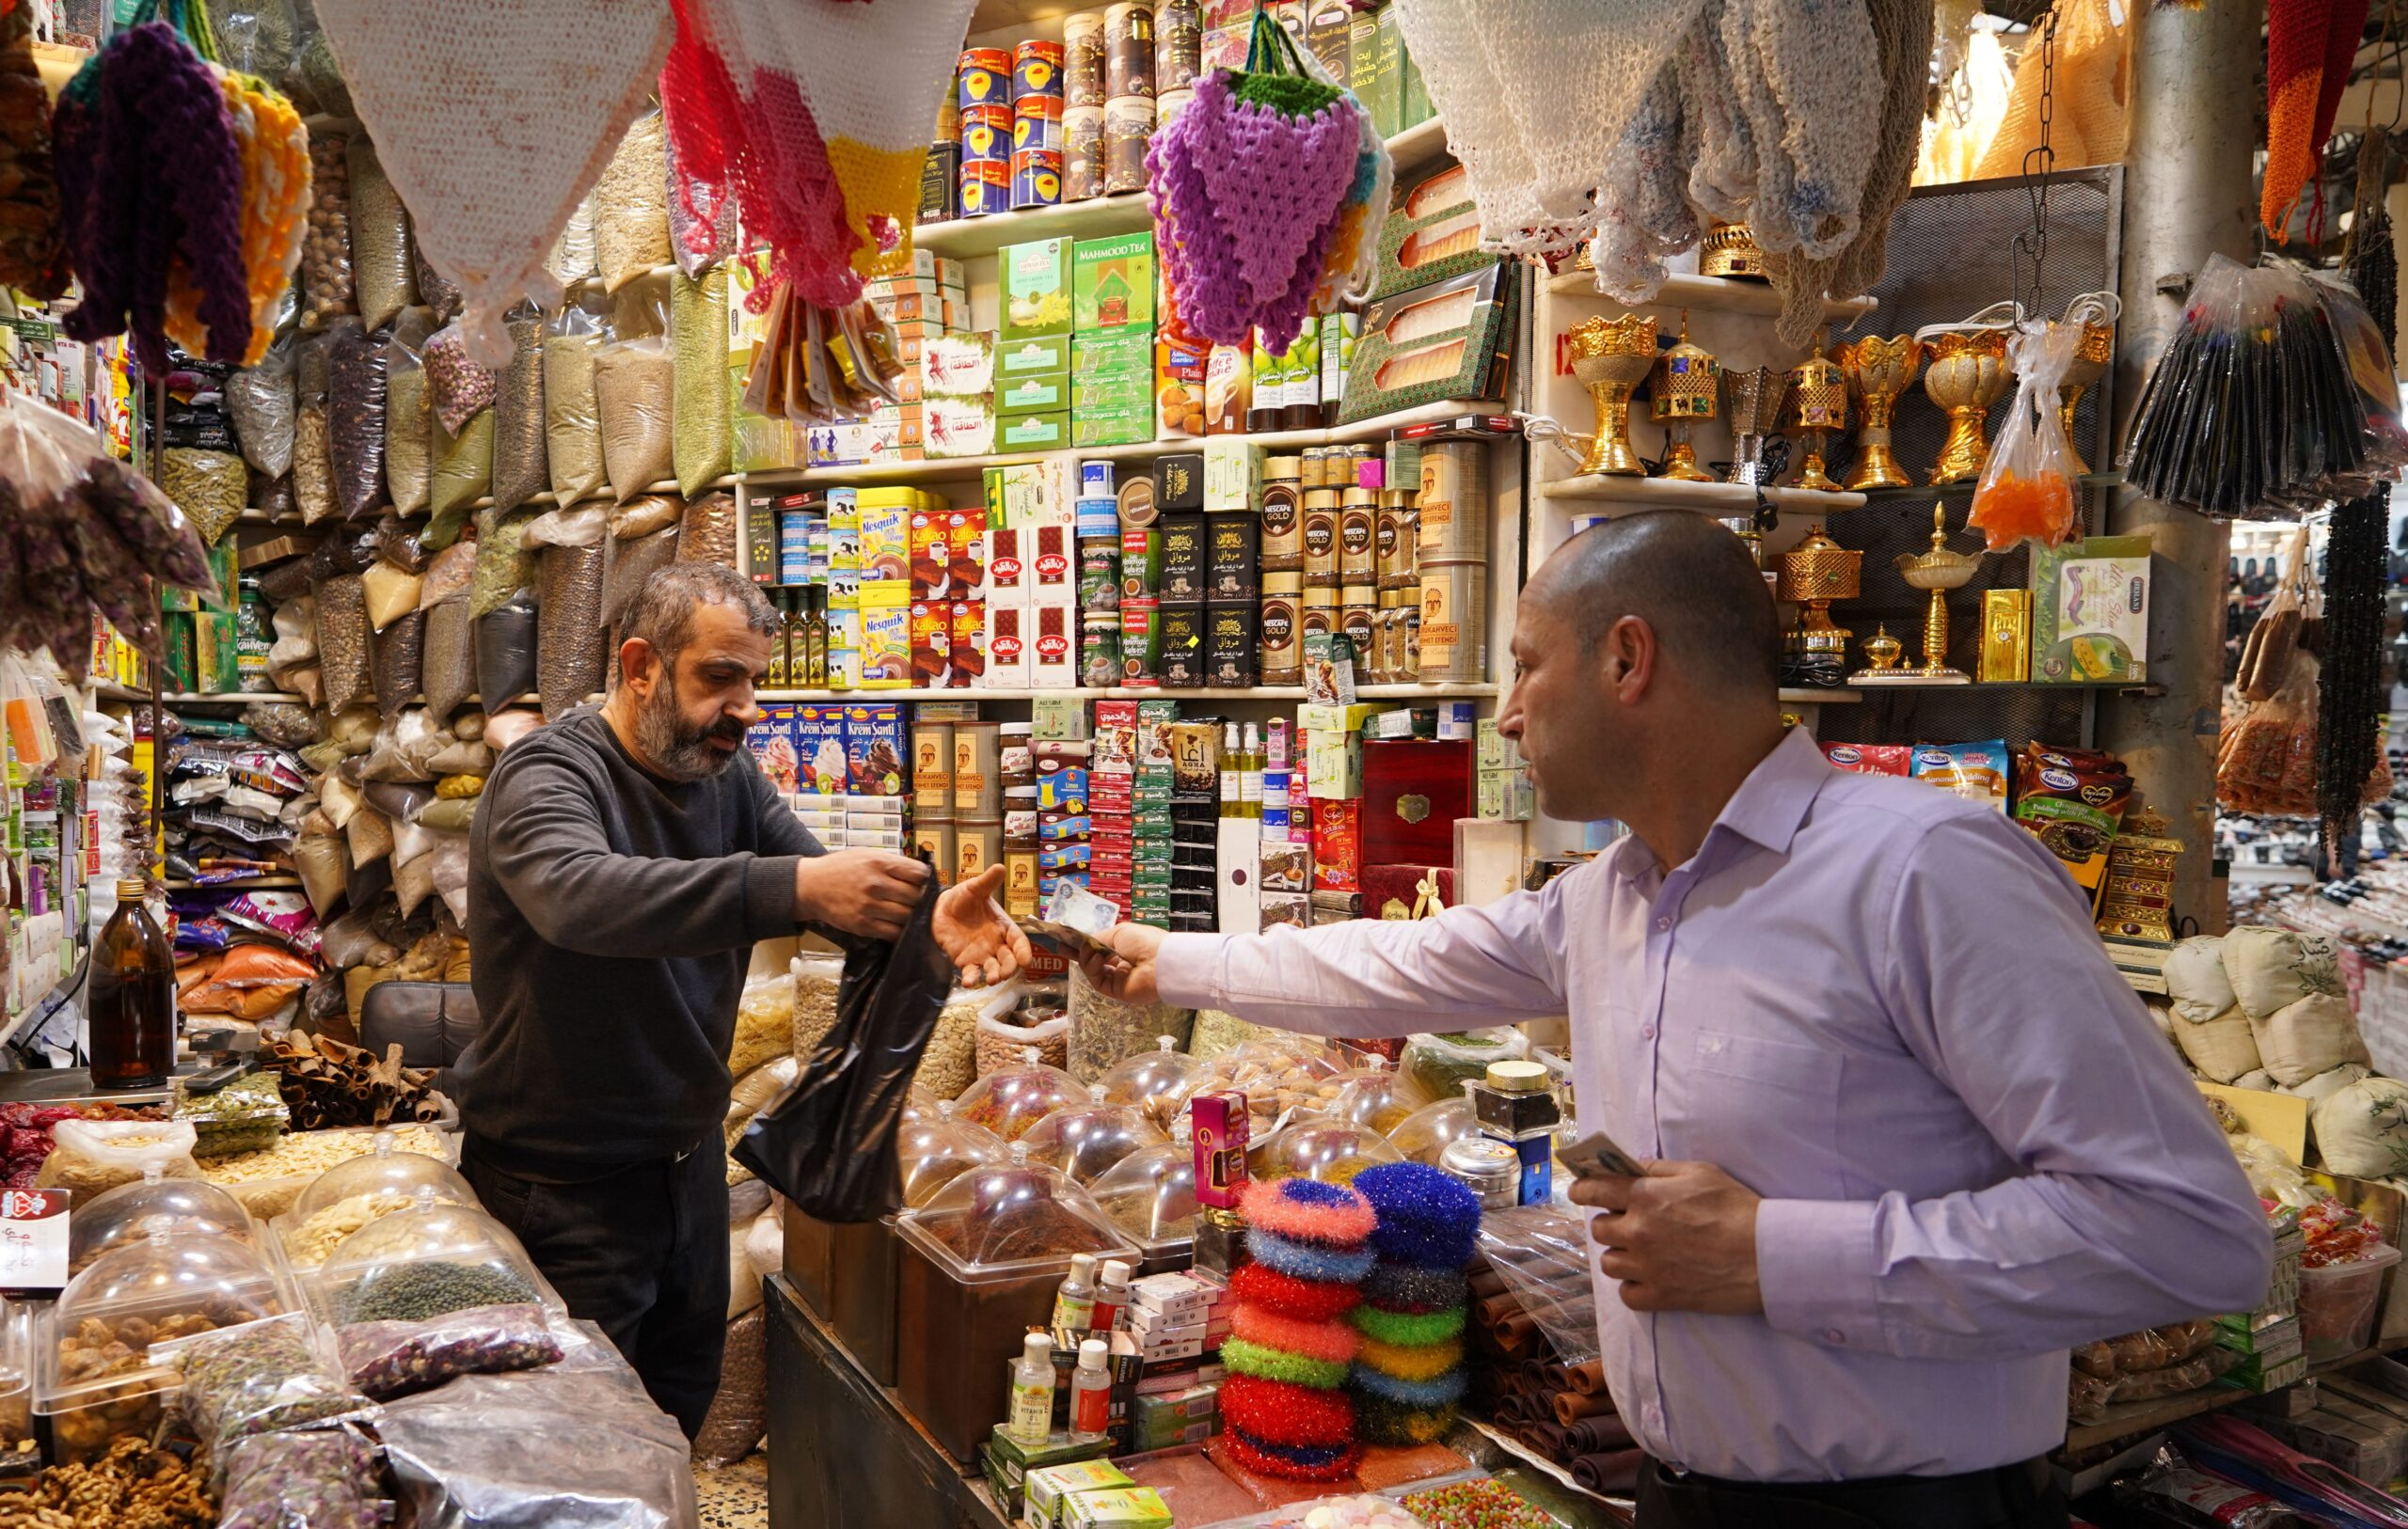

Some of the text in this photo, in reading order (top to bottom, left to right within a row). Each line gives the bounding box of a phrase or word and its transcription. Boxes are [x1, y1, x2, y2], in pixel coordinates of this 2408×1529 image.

[1079, 243, 1146, 260] MAHMOOD TEA
[1208, 356, 1233, 371] offee
[1181, 368, 1202, 378] Plain
[862, 513, 899, 533] Nesquik
[1267, 512, 1290, 521] GOLD
[912, 529, 946, 543] Kakao
[950, 528, 984, 542] Kakao
[1307, 536, 1327, 544] GOLD
[1345, 533, 1365, 542] GOLD
[1169, 553, 1191, 565] مرواني
[1218, 551, 1240, 563] مرواني
[866, 613, 904, 633] Nesquik
[912, 619, 947, 632] Kakao
[1265, 626, 1287, 635] GOLD
[1218, 638, 1239, 650] مرواني
[769, 721, 791, 736] Şanti
[800, 721, 841, 736] Krem Şanti
[848, 721, 895, 737] Krem Şanti
[1180, 740, 1205, 763] آغا
[1834, 750, 1859, 761] Kenton
[2044, 772, 2073, 787] Kenton
[2055, 801, 2089, 813] Chocolate
[2034, 804, 2060, 815] Pudding
[2077, 812, 2107, 828] Pistachio
[1031, 956, 1063, 971] MED
